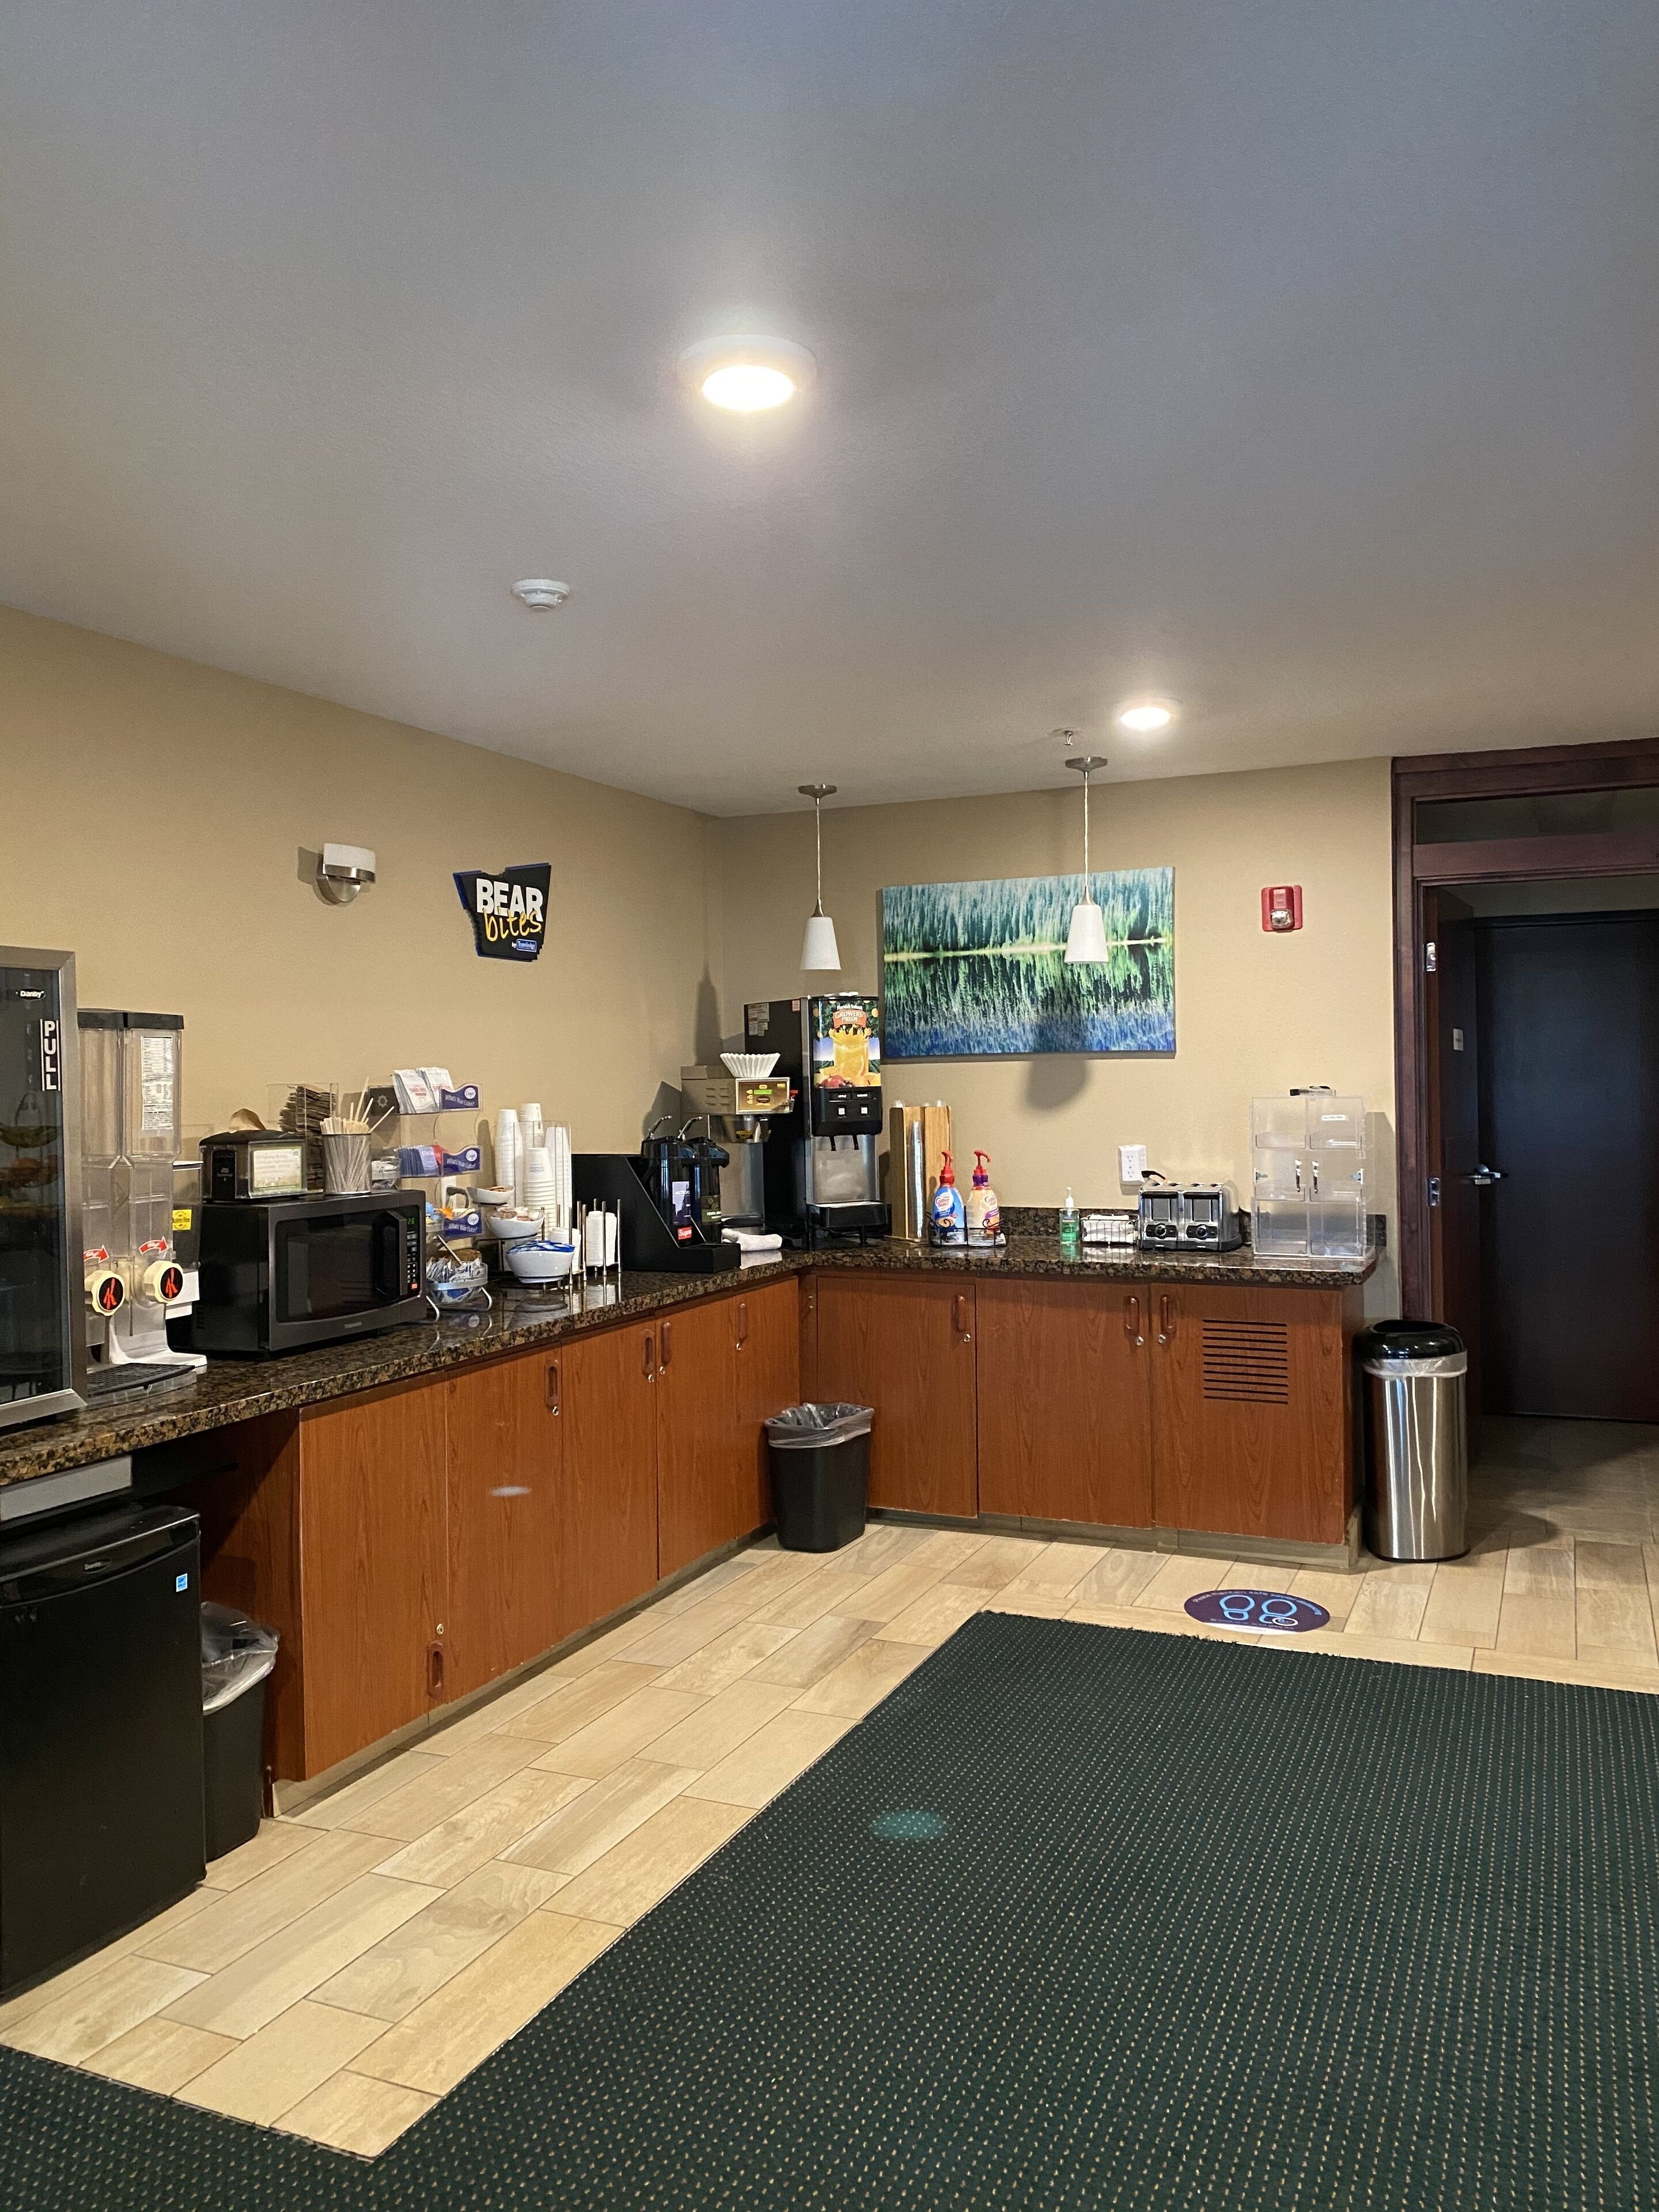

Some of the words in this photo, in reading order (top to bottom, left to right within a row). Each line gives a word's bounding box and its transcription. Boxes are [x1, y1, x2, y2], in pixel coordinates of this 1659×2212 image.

[476, 878, 543, 922] BEAR
[482, 906, 542, 942] bites
[20, 990, 43, 998] Danby
[835, 1011, 863, 1019] GROWERS
[44, 1020, 57, 1090] PULL
